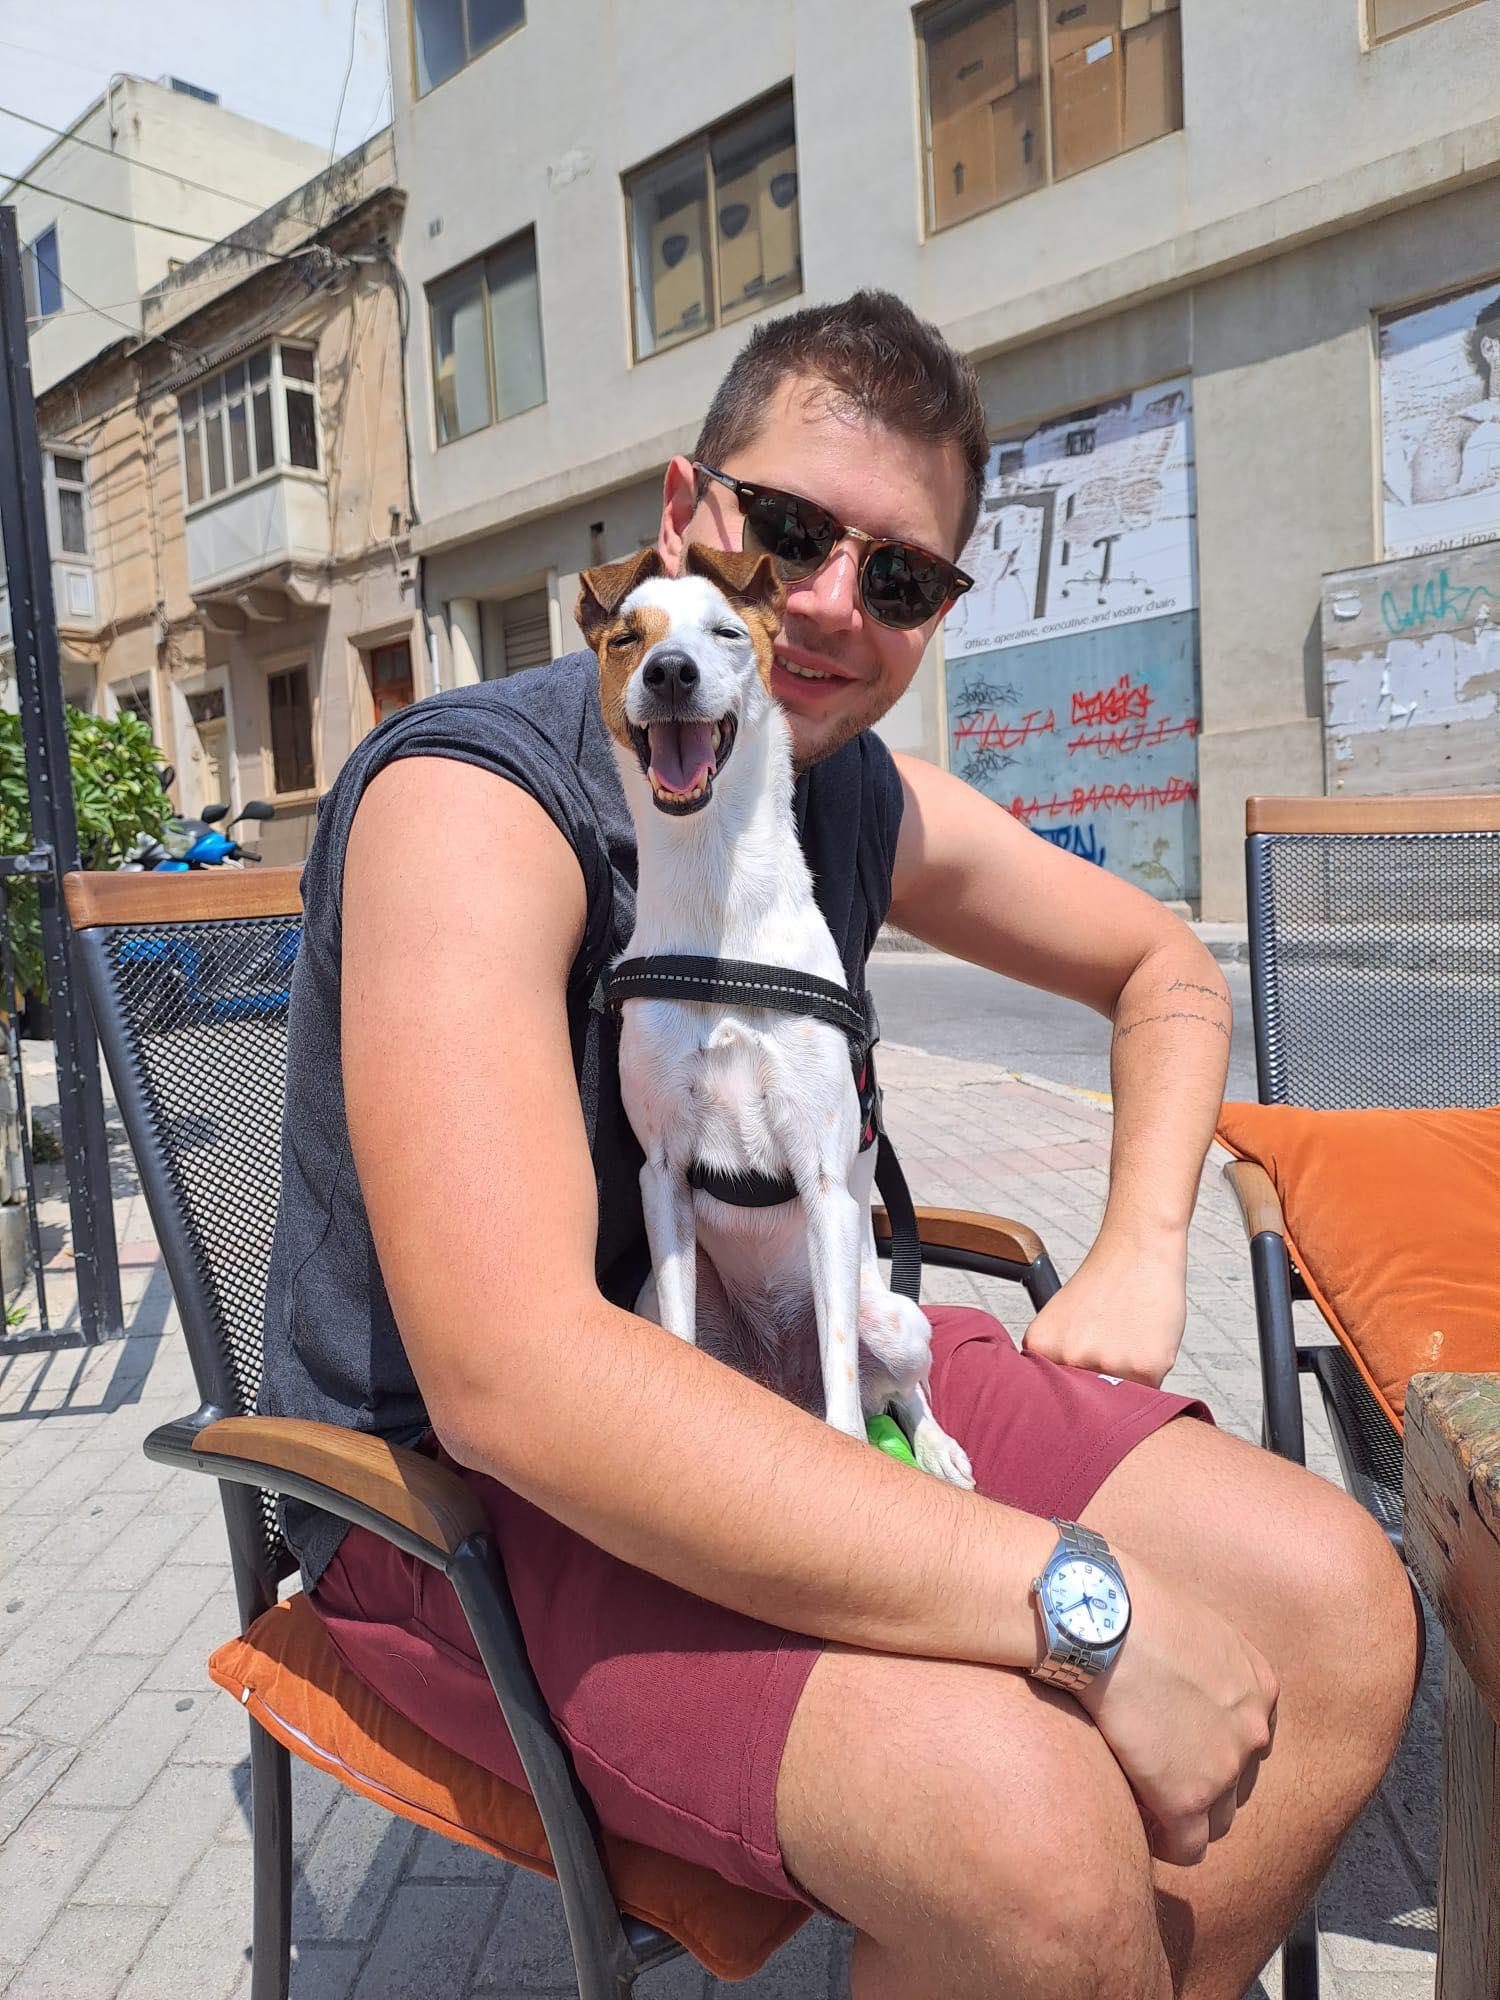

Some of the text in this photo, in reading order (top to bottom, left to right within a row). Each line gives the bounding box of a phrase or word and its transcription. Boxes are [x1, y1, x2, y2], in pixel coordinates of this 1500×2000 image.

[1042, 615, 1089, 633] executive
[1091, 608, 1111, 624] and
[1113, 602, 1144, 619] visitor
[1146, 597, 1176, 613] chairs
